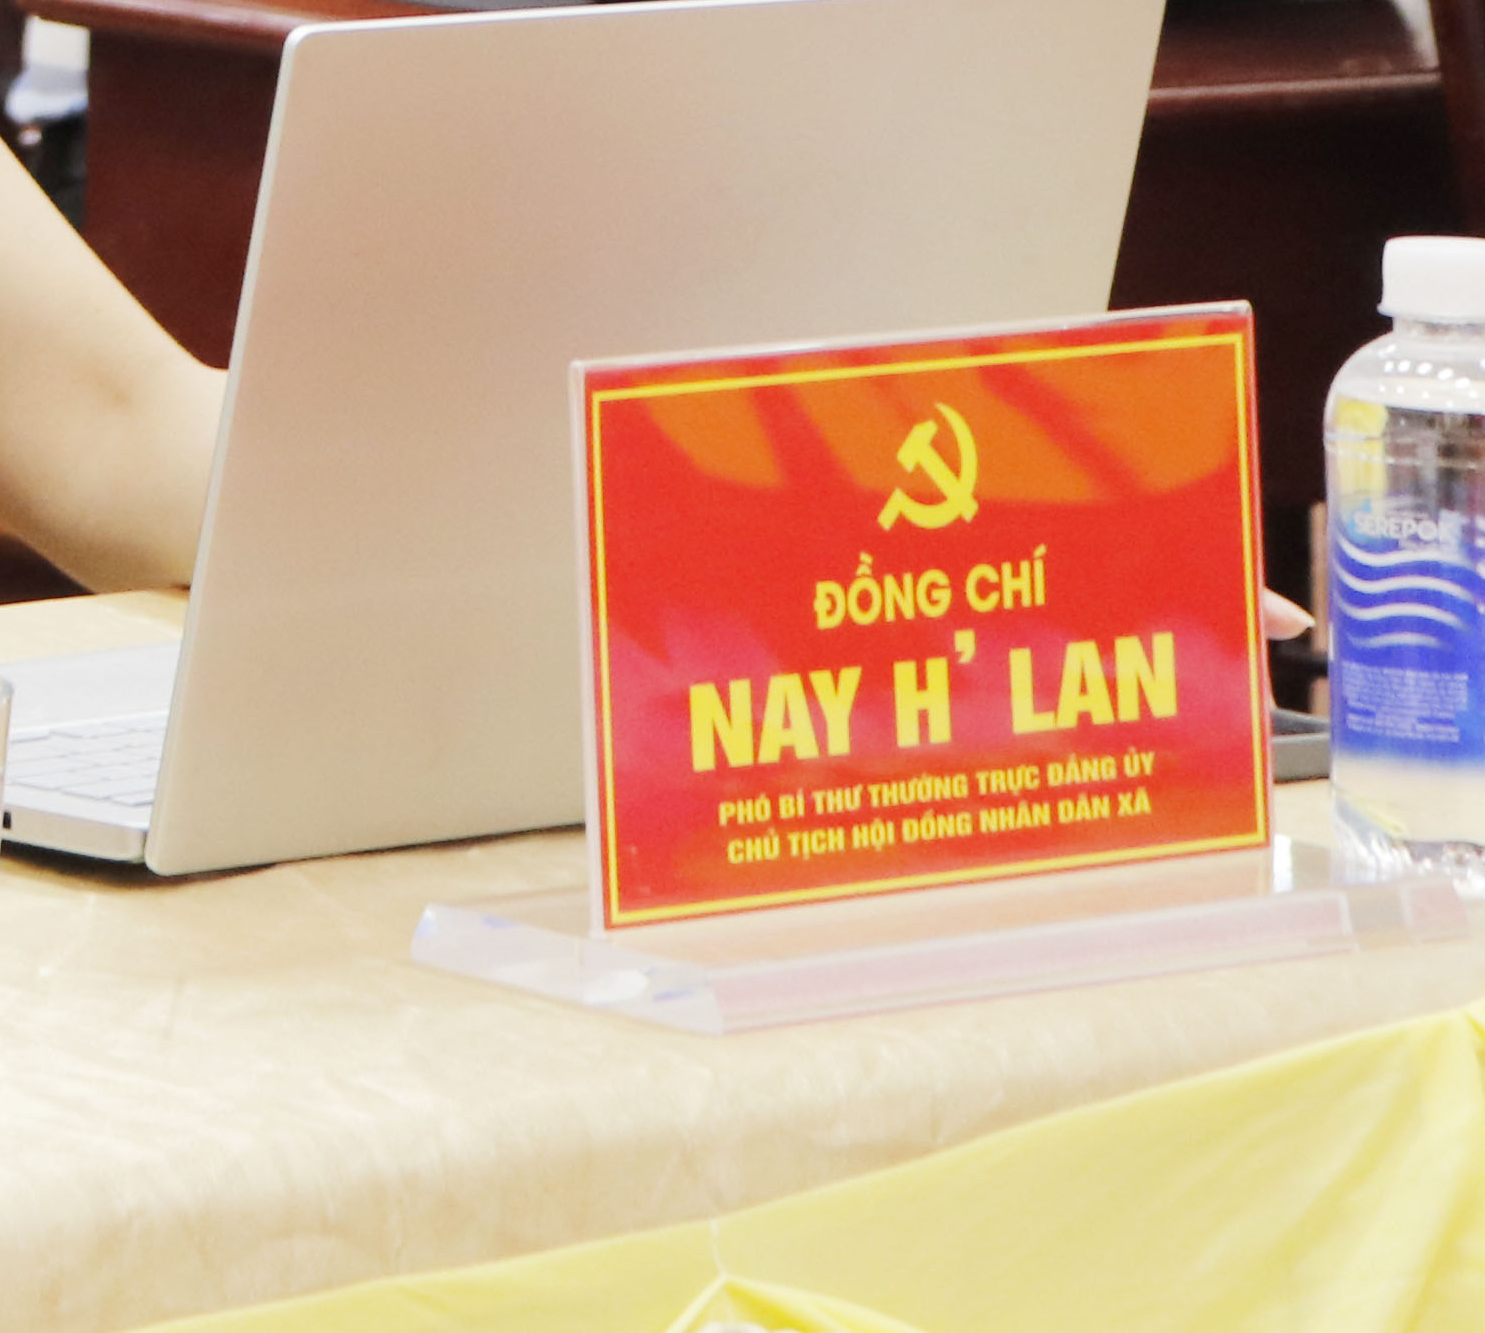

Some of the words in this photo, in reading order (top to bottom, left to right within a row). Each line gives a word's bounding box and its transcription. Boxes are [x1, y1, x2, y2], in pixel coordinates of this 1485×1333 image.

[814, 553, 951, 629] ĐỒNG
[966, 545, 1046, 612] CHÍ
[690, 667, 861, 772] NAY
[1009, 632, 1177, 735] LAN
